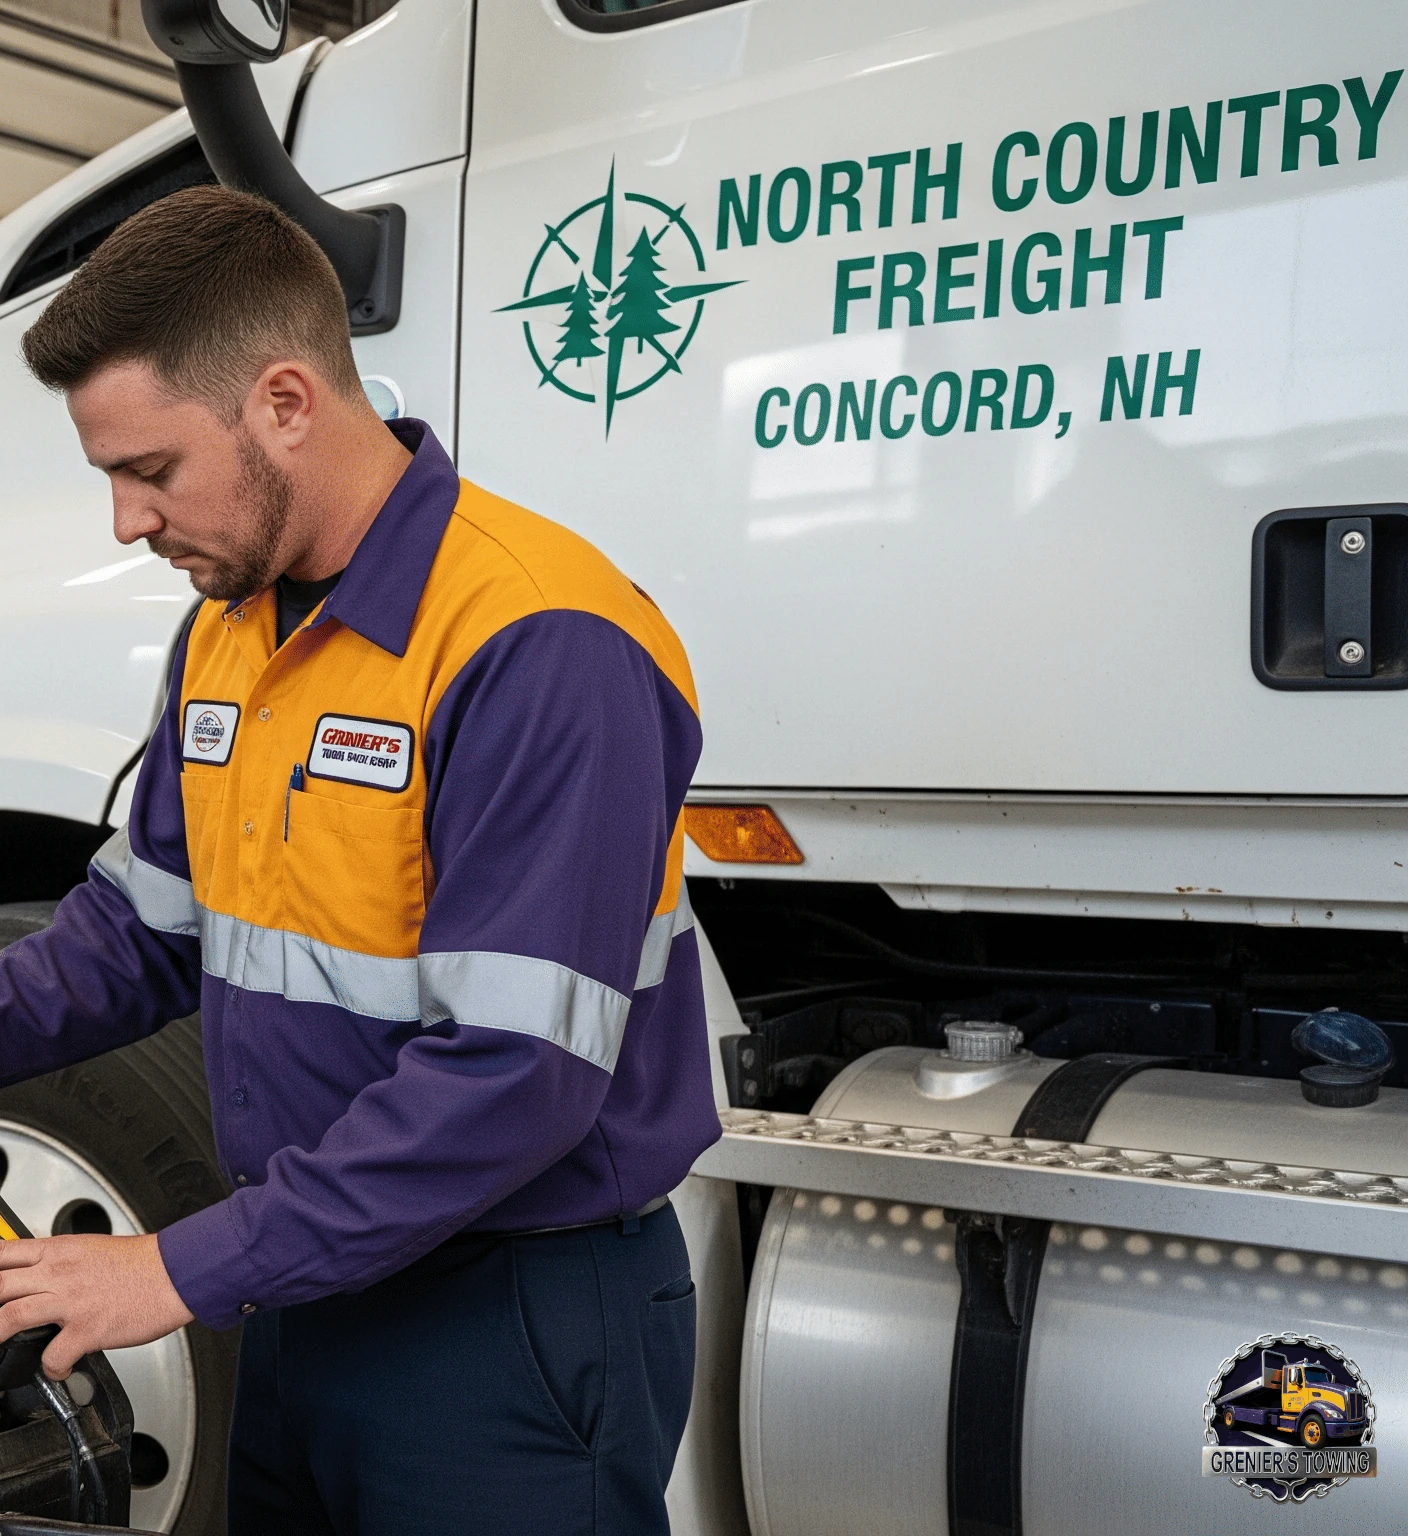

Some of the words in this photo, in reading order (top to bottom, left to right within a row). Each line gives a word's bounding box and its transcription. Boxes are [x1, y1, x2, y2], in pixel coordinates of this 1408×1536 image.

[715, 143, 962, 251] NORTH
[992, 69, 1404, 212] COUNTRY
[833, 216, 1184, 335] FREIGHT
[754, 363, 1072, 449] CONCORD,
[1099, 348, 1202, 423] NH
